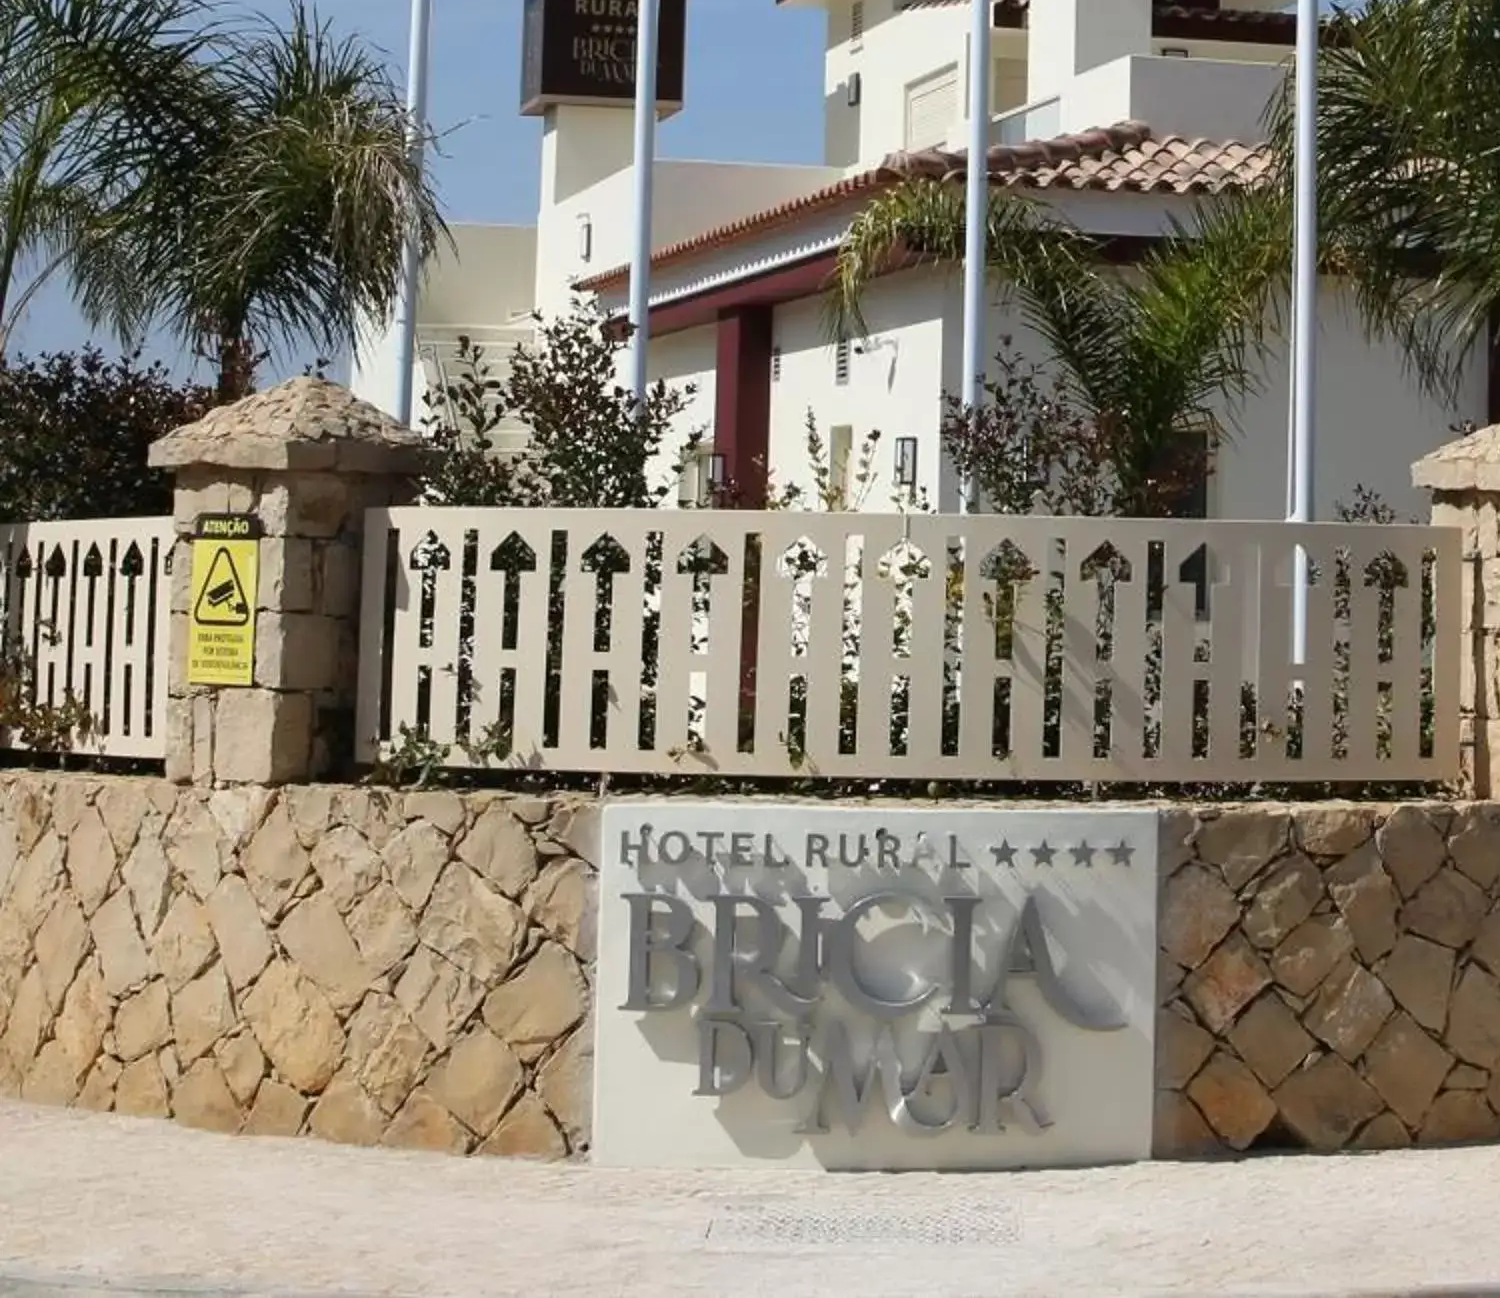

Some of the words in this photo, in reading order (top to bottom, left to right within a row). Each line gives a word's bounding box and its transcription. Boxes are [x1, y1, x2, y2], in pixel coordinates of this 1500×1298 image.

[572, 35, 637, 63] BRICI
[202, 517, 249, 538] ATENÇÃO
[619, 827, 790, 870] HOTEL
[804, 831, 972, 869] RURAL
[617, 892, 1129, 1031] BRICIA
